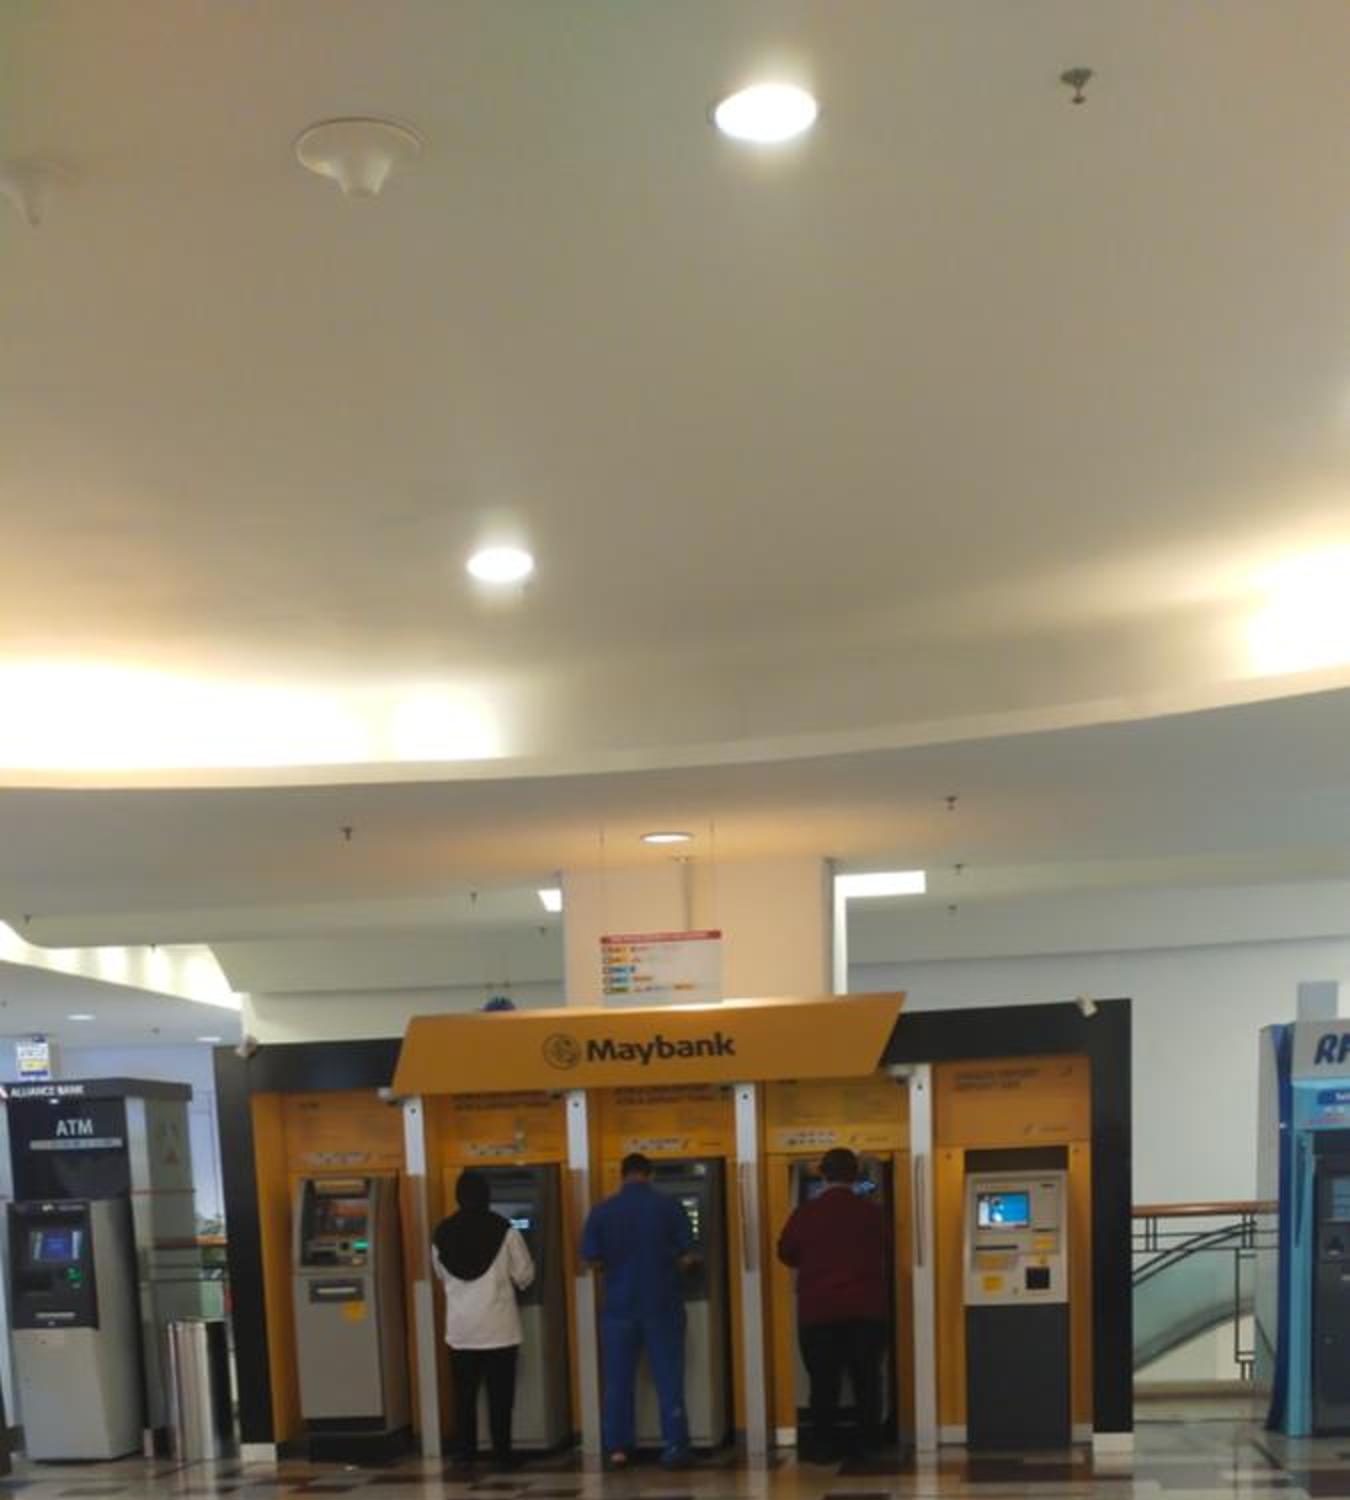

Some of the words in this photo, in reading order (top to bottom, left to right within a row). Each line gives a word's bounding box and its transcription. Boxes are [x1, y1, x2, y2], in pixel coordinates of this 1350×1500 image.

[586, 1031, 736, 1066] Maybank
[10, 1086, 55, 1097] ALLIANCE
[57, 1085, 85, 1095] BANK
[56, 1119, 94, 1137] ATM
